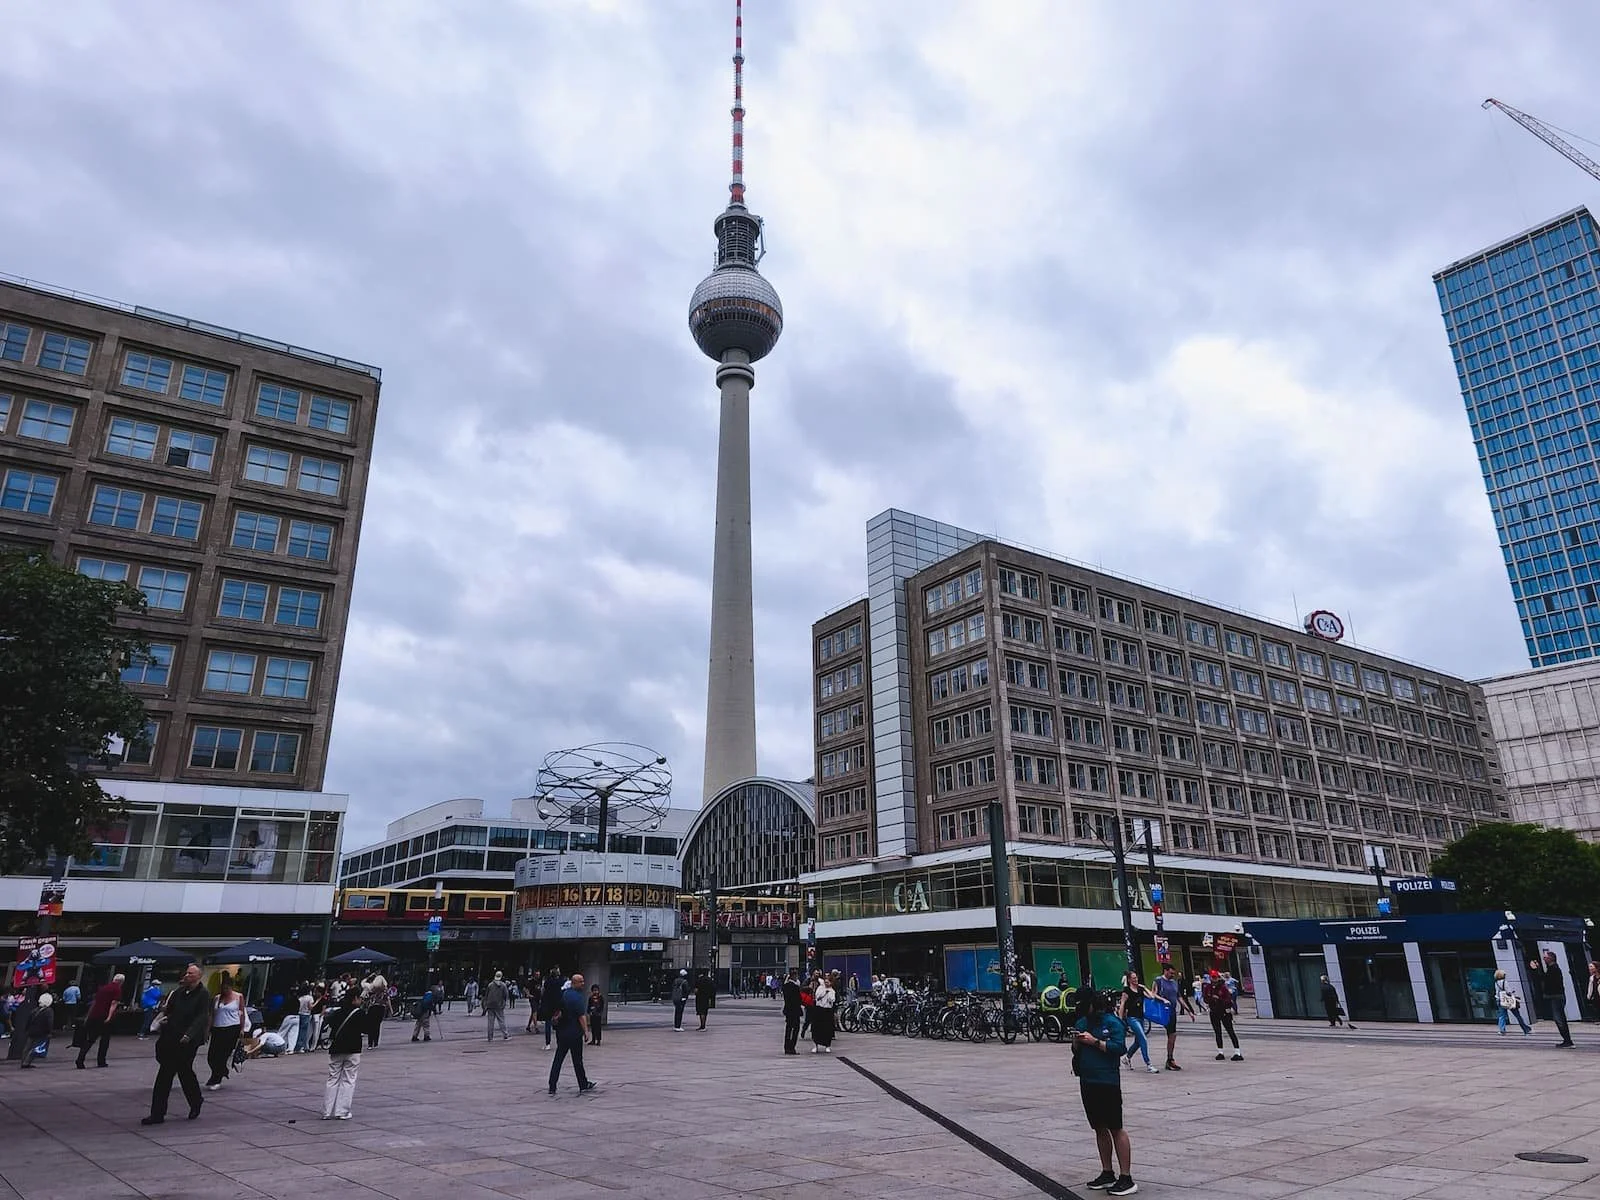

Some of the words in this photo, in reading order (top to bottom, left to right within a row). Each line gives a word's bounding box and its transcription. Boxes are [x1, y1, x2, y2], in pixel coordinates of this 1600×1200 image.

[1397, 881, 1433, 891] POLIZEI
[562, 887, 579, 902] 16
[583, 887, 601, 902] 17
[606, 887, 623, 902] 18
[628, 888, 643, 902] 19
[647, 889, 660, 903] 20
[893, 880, 930, 912] C&A
[1350, 926, 1380, 935] POLIZEI
